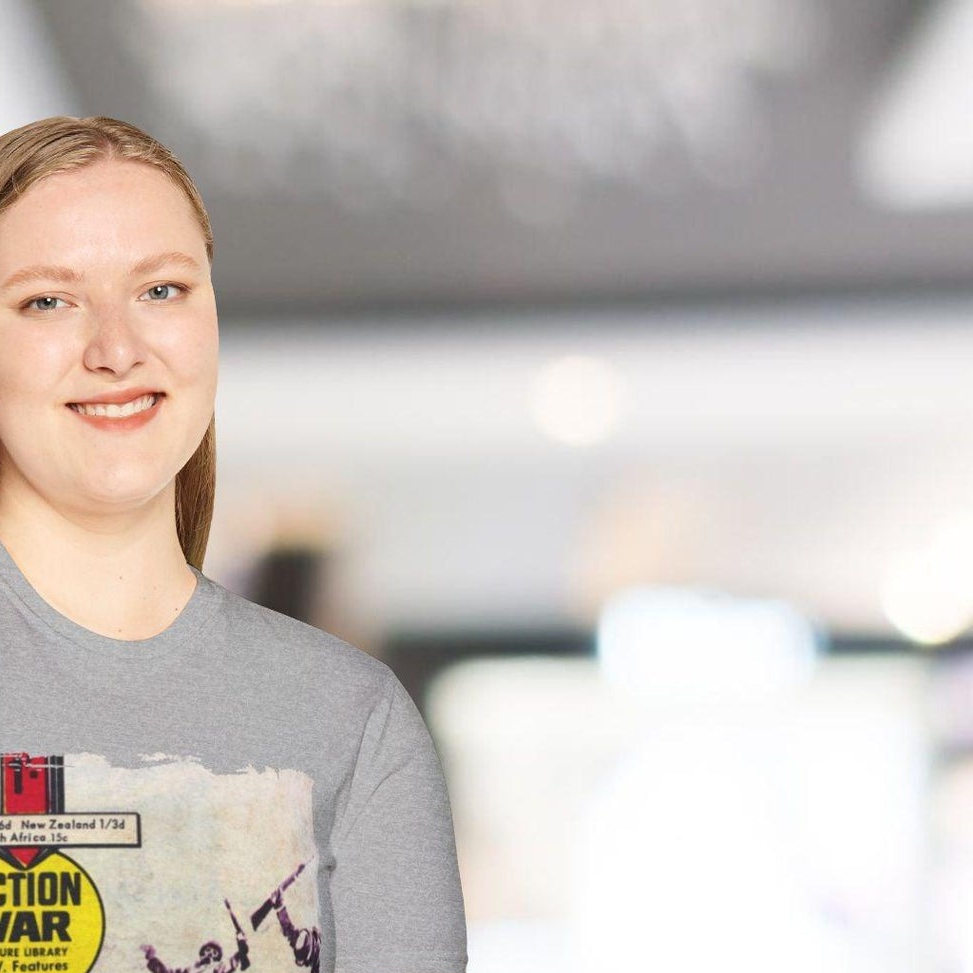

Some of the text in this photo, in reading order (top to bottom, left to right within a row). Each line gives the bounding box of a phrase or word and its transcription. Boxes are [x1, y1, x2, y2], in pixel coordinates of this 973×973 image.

[20, 819, 45, 830] New
[48, 817, 96, 830] Zealand
[99, 818, 125, 830] 1/3d
[10, 832, 46, 843] Africa
[51, 832, 68, 842] 15c
[24, 948, 68, 957] LIBRARY
[12, 960, 68, 972] Features
